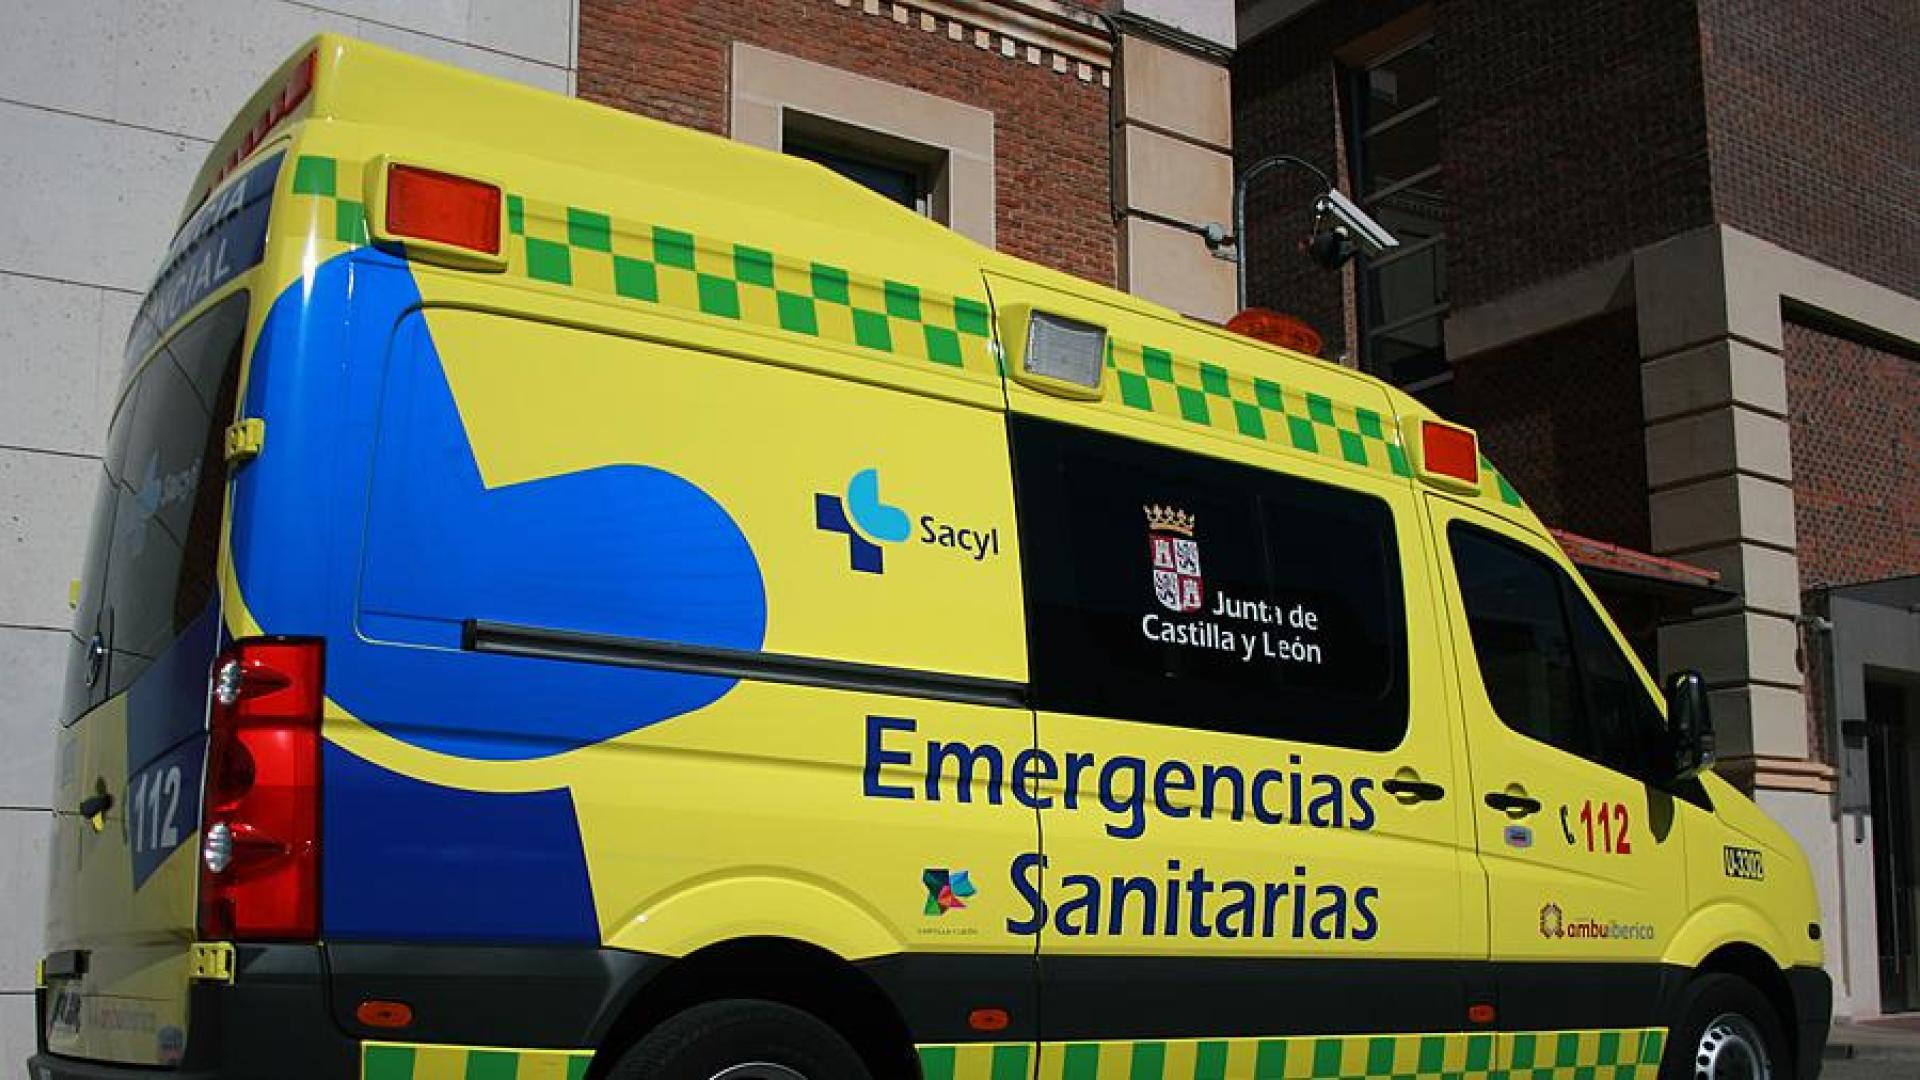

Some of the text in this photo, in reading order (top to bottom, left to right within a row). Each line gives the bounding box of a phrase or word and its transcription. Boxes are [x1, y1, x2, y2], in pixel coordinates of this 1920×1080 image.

[921, 515, 999, 560] Sacyl
[1142, 613, 1322, 664] Castilla y León
[1289, 603, 1319, 631] de
[863, 714, 1376, 840] Emergencias
[134, 765, 182, 853] 112
[1579, 799, 1632, 855] 112
[1005, 852, 1380, 941] Sanitarias
